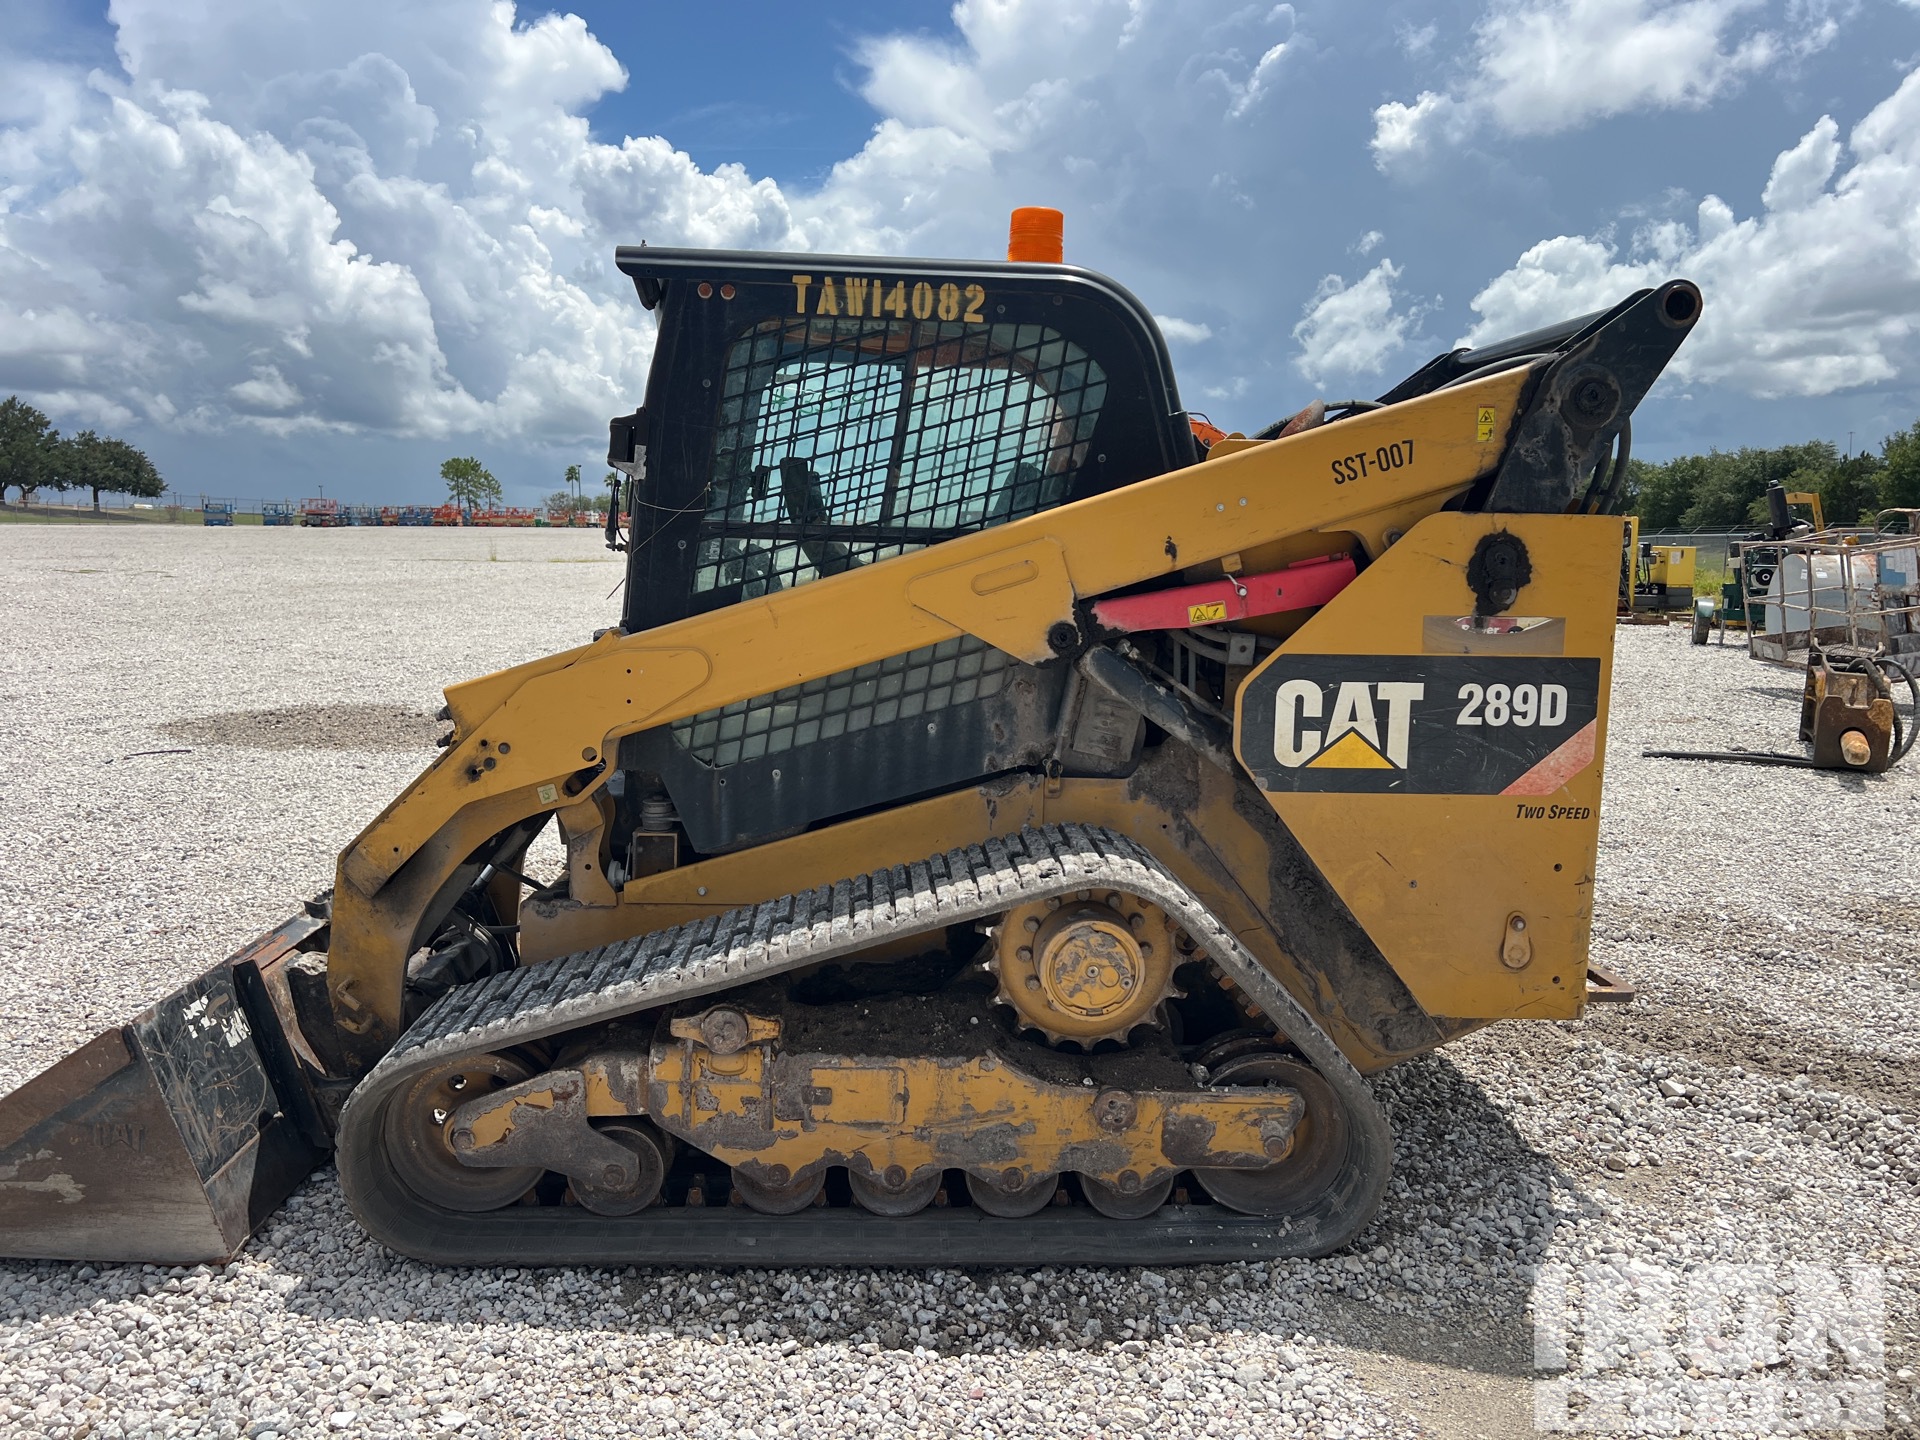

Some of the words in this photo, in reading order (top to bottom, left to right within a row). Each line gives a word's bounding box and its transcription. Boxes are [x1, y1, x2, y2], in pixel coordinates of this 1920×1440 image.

[1331, 439, 1414, 485] SST-007
[1274, 679, 1424, 769] CAT
[1456, 682, 1568, 728] 289D
